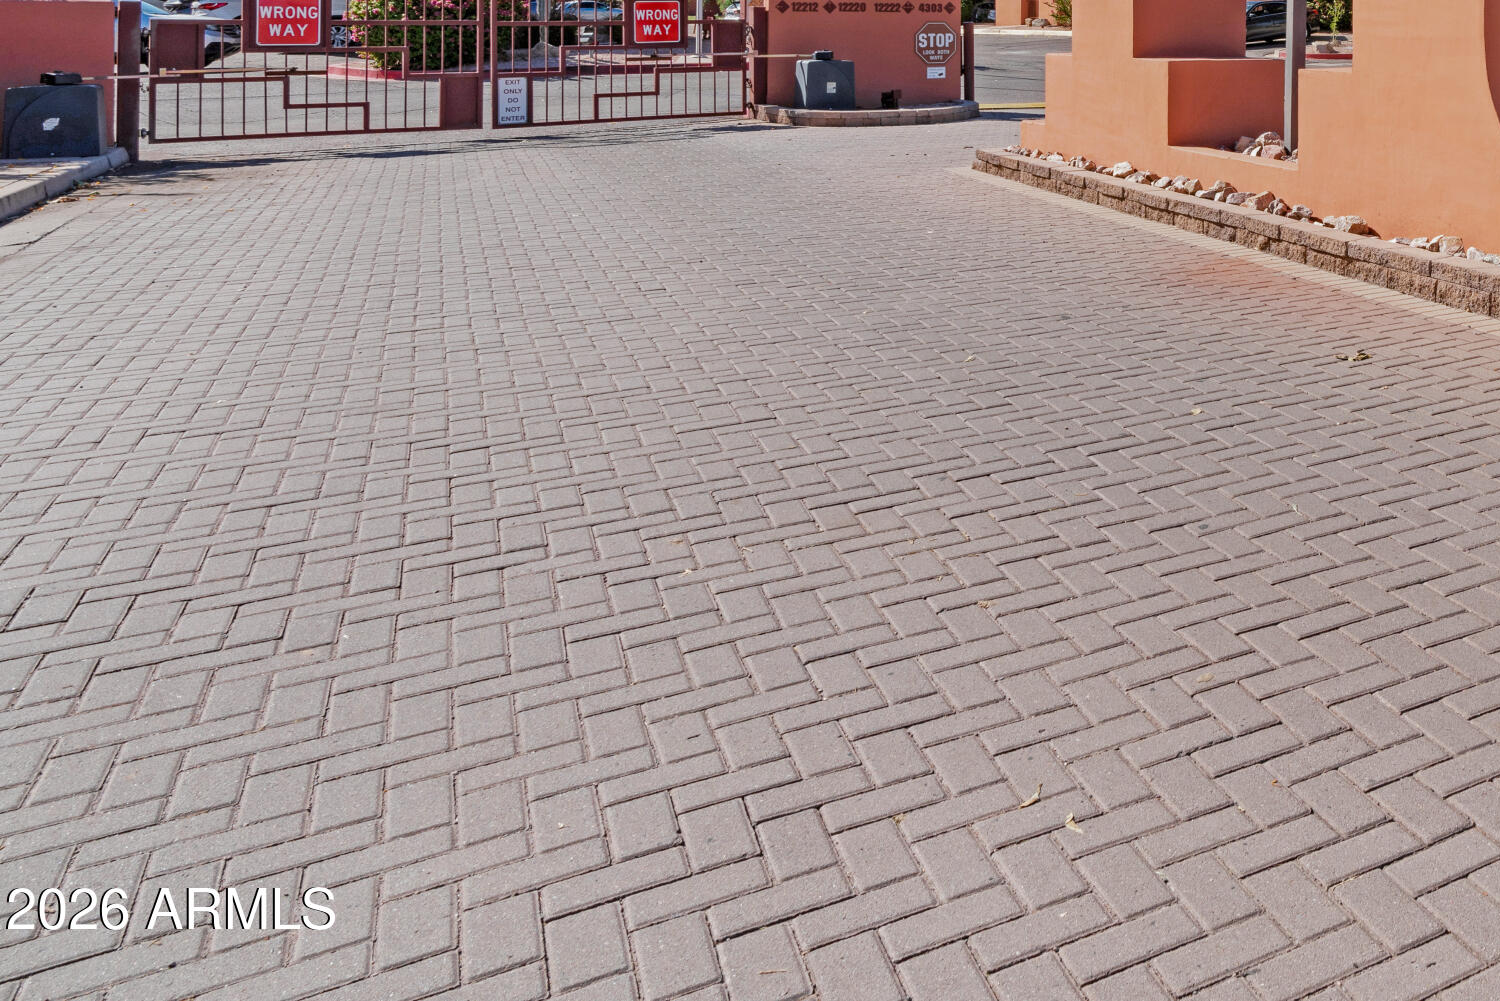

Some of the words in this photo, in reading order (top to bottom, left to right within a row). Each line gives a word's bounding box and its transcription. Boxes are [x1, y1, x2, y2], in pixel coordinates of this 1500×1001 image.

[259, 5, 319, 19] WRONG
[791, 1, 819, 12] 12212
[838, 2, 866, 13] 12220
[874, 2, 901, 13] 12222
[918, 3, 943, 13] 4303
[636, 9, 678, 21] WRONG
[269, 23, 308, 37] WAY
[642, 24, 672, 36] WAY
[918, 33, 954, 48] STOP
